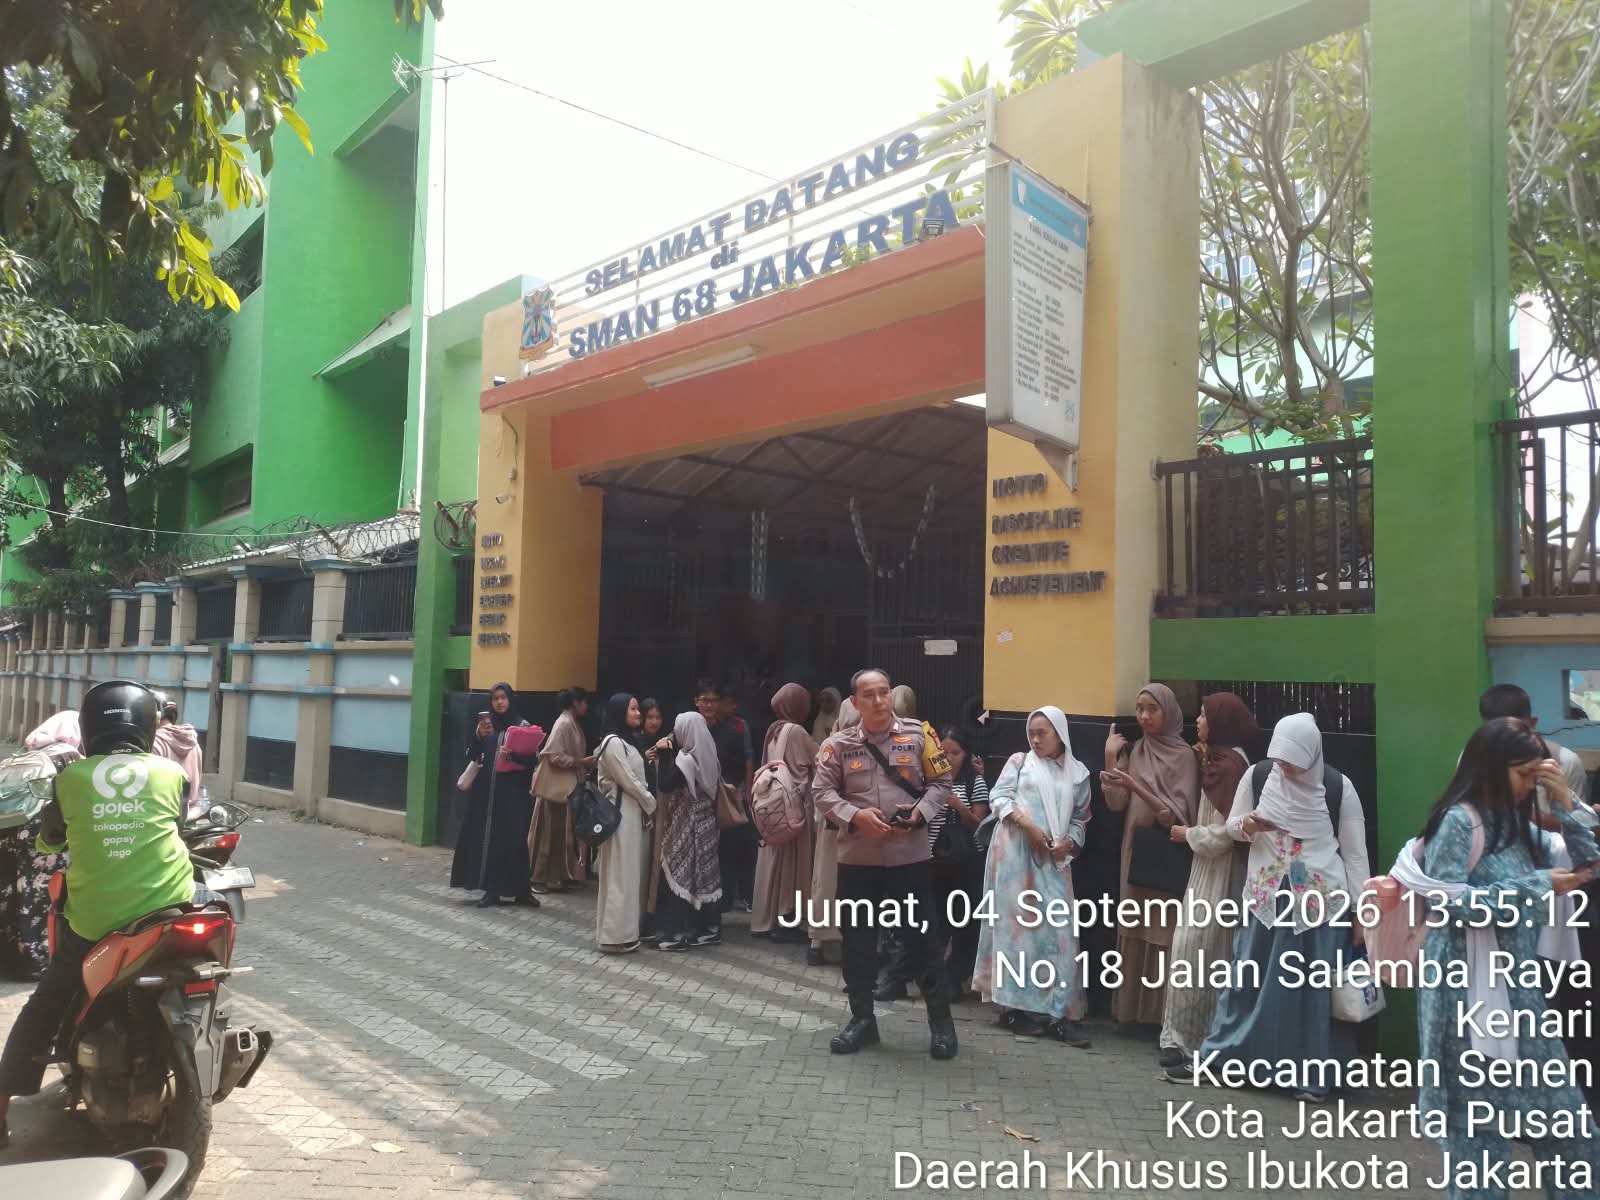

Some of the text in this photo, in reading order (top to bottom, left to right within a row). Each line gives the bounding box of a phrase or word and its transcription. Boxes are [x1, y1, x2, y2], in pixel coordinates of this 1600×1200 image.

[585, 132, 921, 296] SELAMAT DATANG
[710, 241, 739, 271] di
[567, 298, 659, 360] SMAN
[671, 278, 718, 323] 68
[729, 190, 960, 303] JAKARTA
[891, 744, 916, 753] POLRI
[92, 799, 147, 819] gojek
